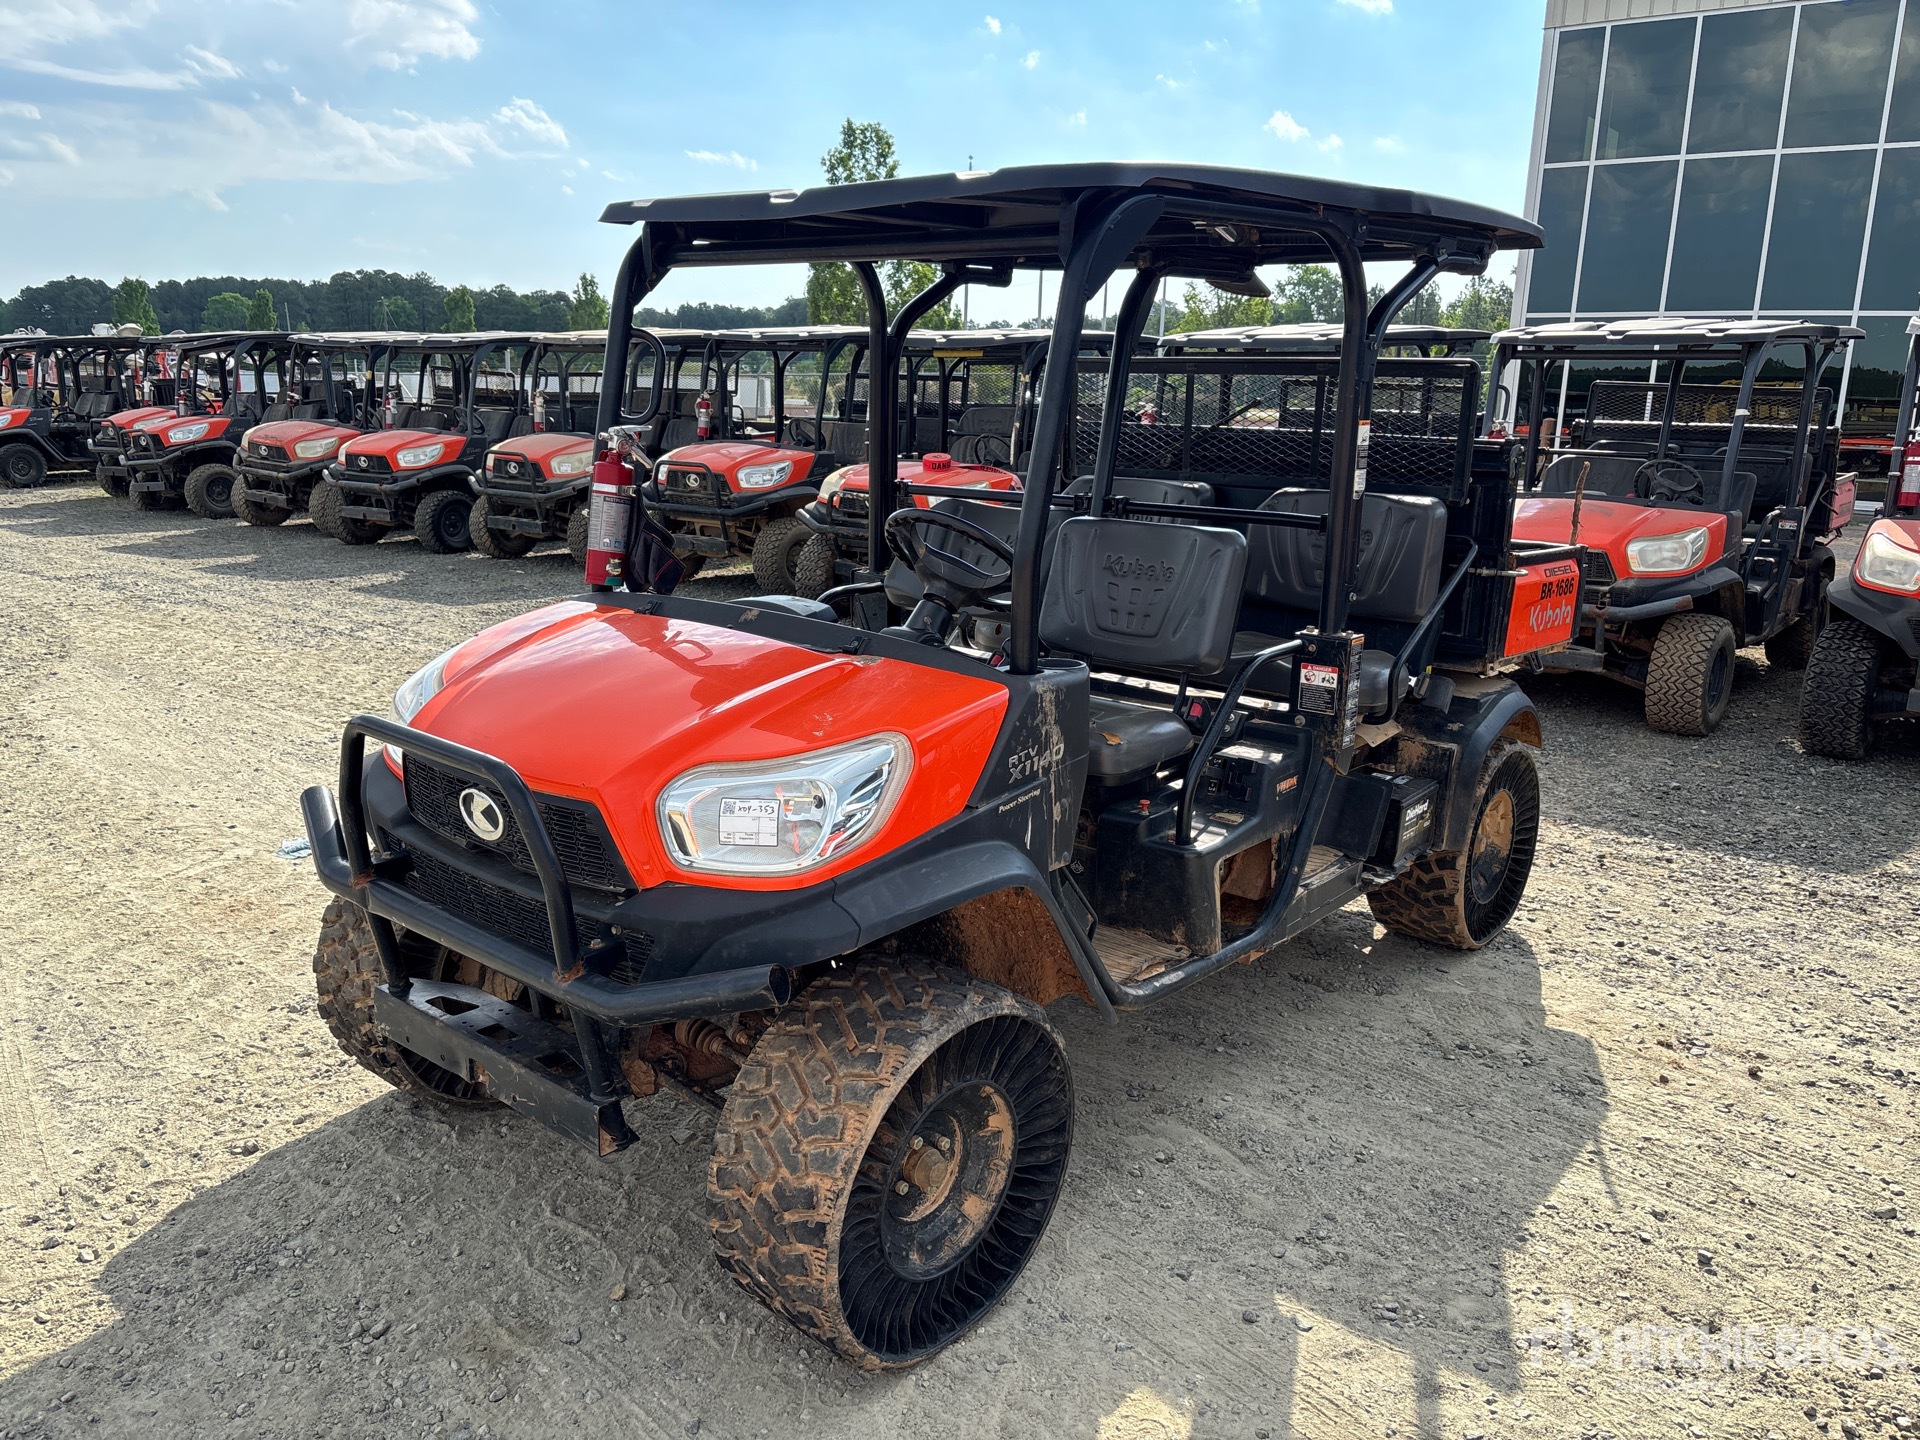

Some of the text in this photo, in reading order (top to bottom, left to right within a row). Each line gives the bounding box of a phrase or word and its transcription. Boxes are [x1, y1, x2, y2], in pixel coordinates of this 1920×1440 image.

[1103, 554, 1175, 582] Kubota
[1544, 564, 1576, 578] DIESEL
[1540, 577, 1575, 600] BR-1686
[1529, 599, 1572, 633] Kubota
[1008, 744, 1039, 768] RTV
[1008, 743, 1065, 784] X1140
[998, 788, 1041, 814] Power Steering
[1405, 799, 1430, 821] DieHard
